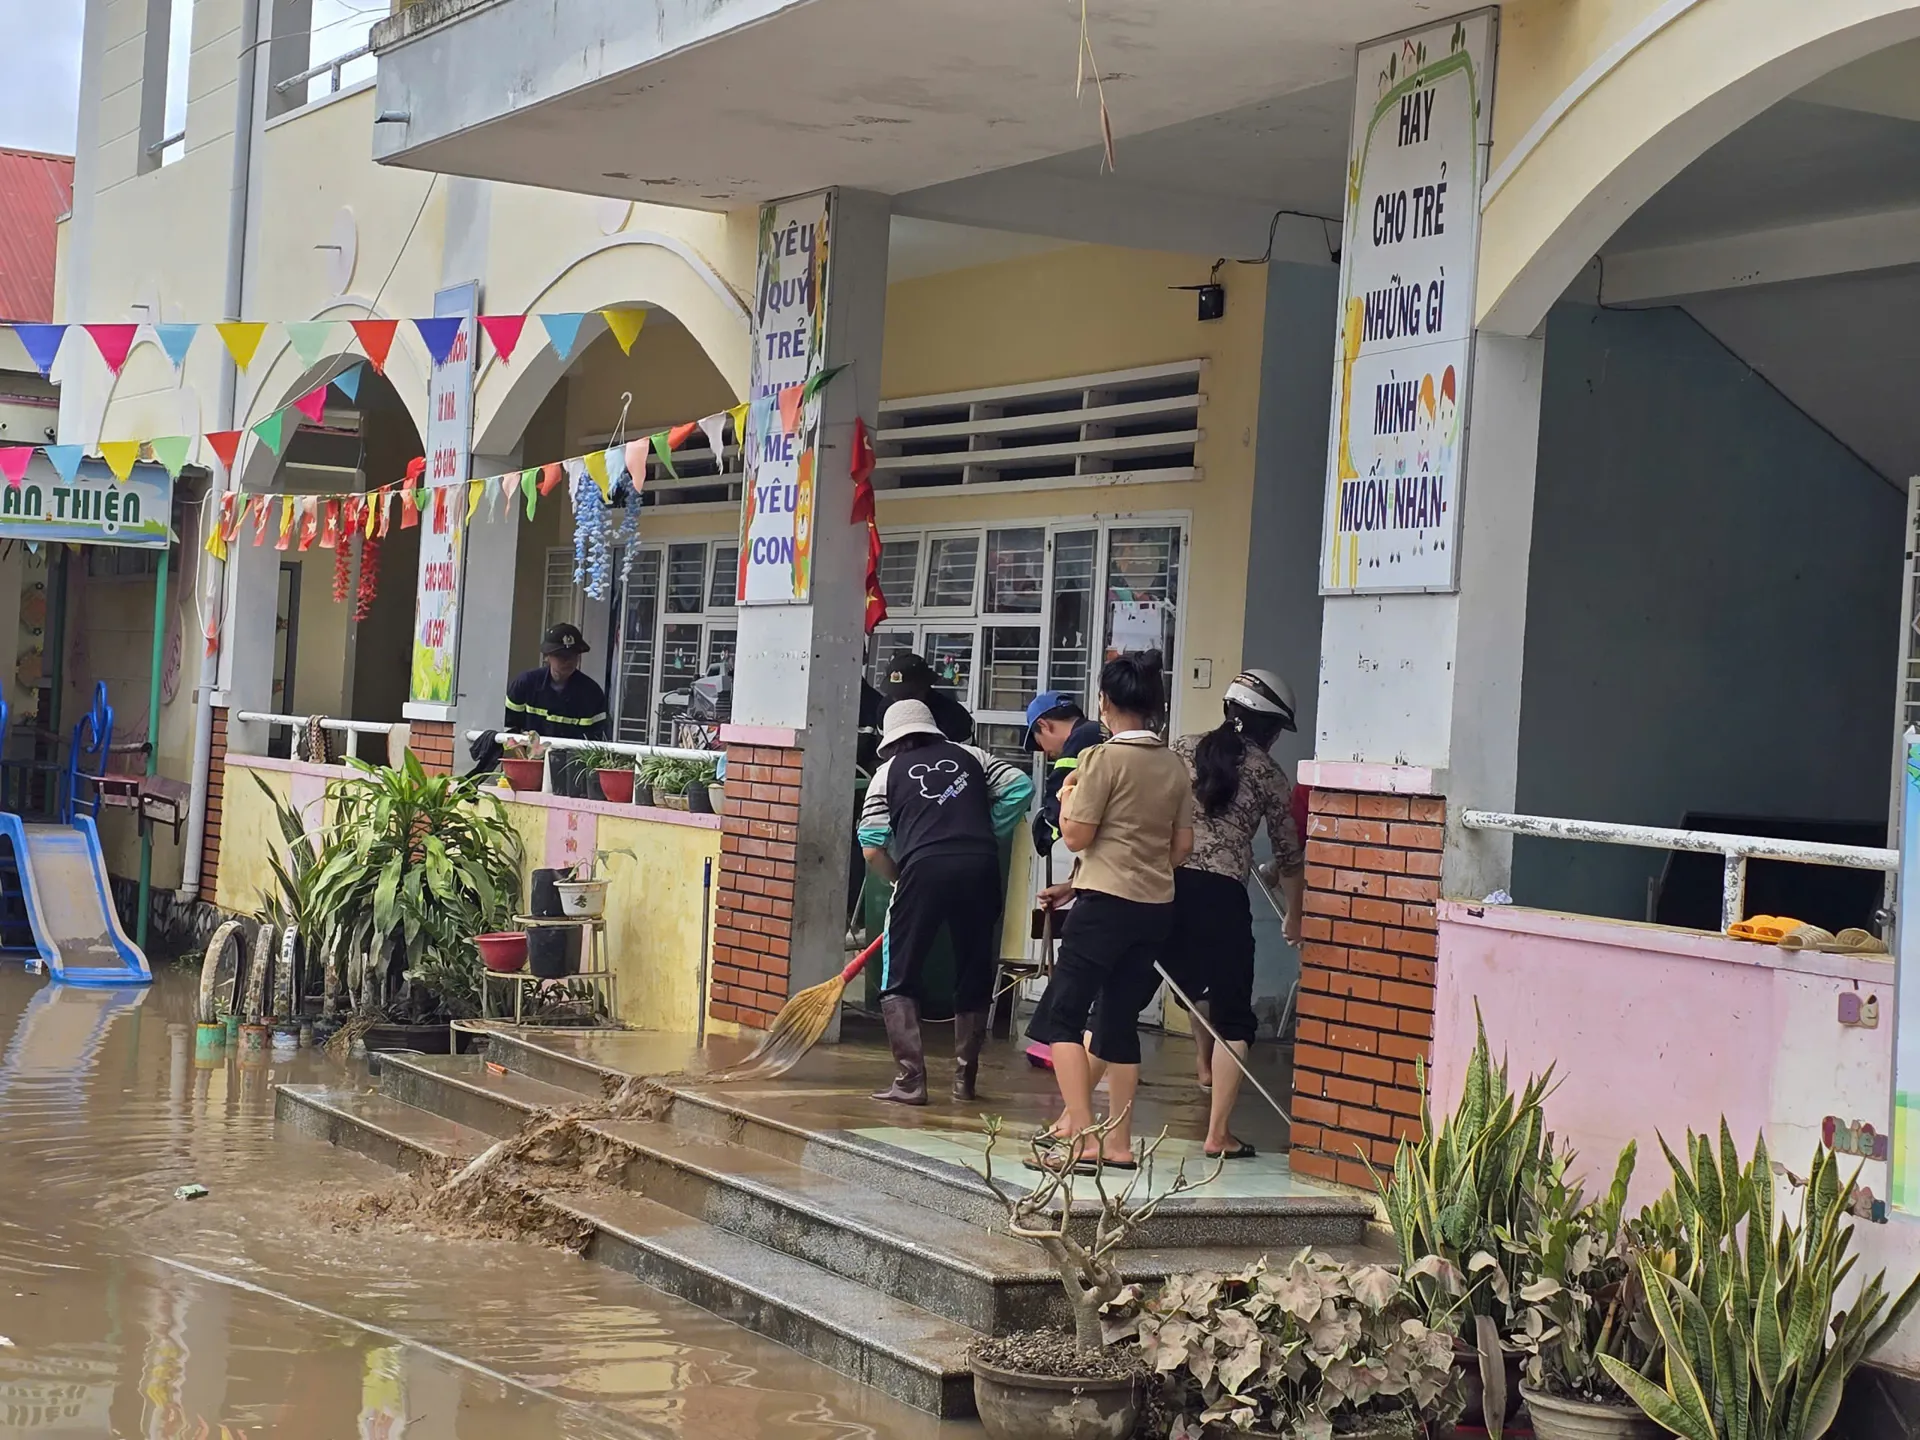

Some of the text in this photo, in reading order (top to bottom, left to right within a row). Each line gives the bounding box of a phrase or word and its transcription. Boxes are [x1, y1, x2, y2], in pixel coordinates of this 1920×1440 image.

[1398, 77, 1436, 147] HÃY
[1373, 161, 1447, 247] CHO TRẺ
[772, 219, 815, 258] YÊU
[768, 268, 810, 314] QUÝ
[1363, 266, 1445, 342] NHỮNG GÌ
[765, 317, 807, 361] TRẺ
[1374, 369, 1419, 435] MÌNH
[764, 433, 795, 467] MẸ
[53, 484, 141, 532] THIỆN
[757, 477, 798, 514] YÊU
[1339, 458, 1389, 532] MUỐN
[753, 535, 795, 565] CON
